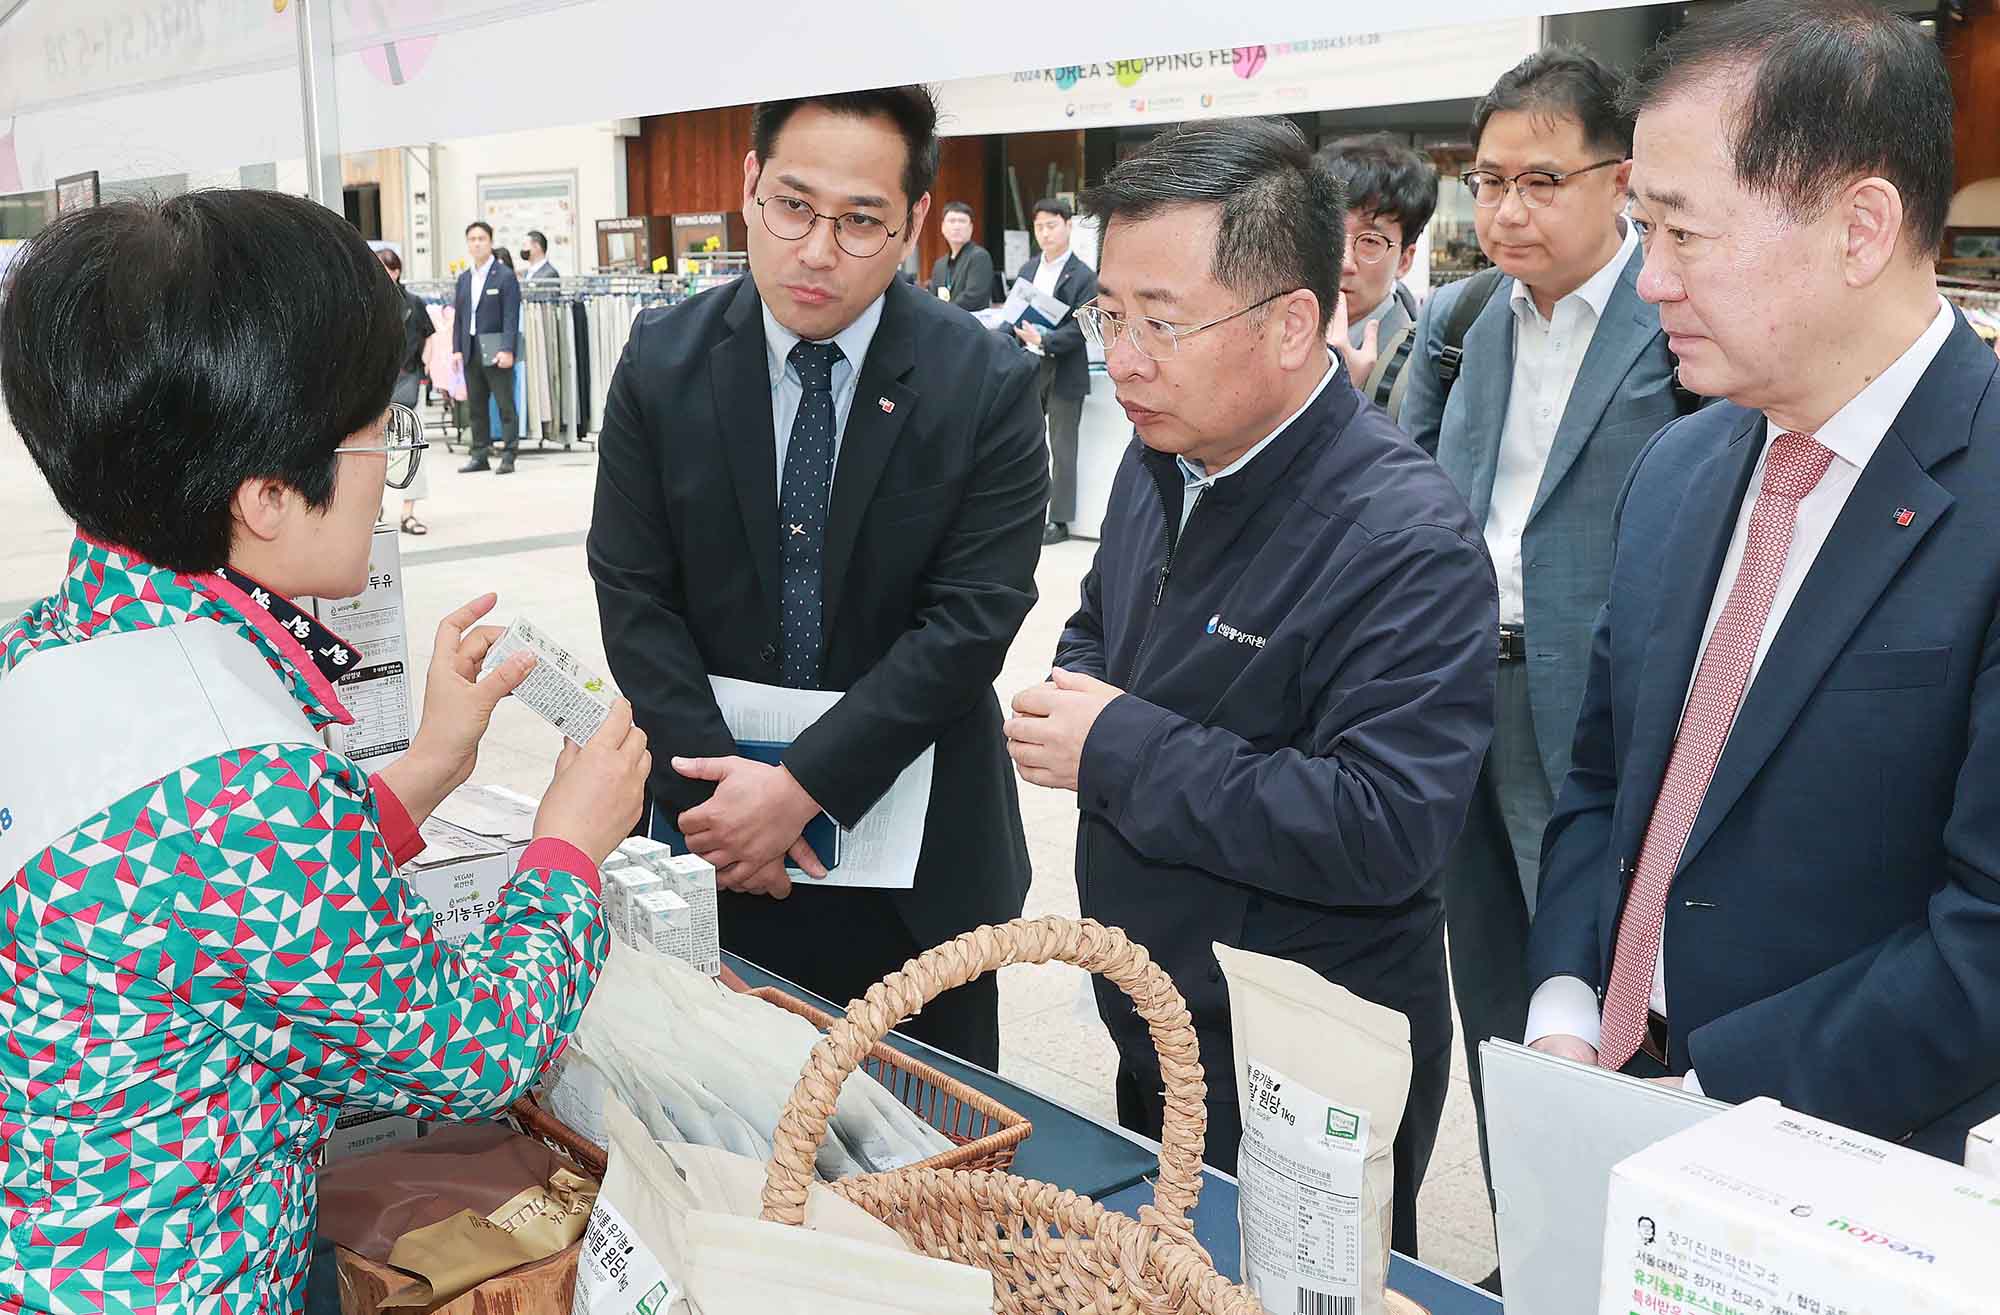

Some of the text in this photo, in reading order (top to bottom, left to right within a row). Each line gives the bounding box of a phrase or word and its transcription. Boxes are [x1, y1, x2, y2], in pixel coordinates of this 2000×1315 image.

[1044, 63, 1101, 82] KOREA
[1106, 50, 1203, 77] SHOPPING
[1209, 45, 1267, 66] FESTA
[454, 872, 474, 882] VEGAN
[1252, 1068, 1274, 1090] 유기농
[1259, 1089, 1281, 1115] 원당
[1281, 1107, 1296, 1127] 1kg
[606, 1223, 629, 1250] 유기농
[600, 1246, 628, 1278] 원당
[1634, 1249, 1689, 1281] 서울대학교
[1693, 1273, 1727, 1297] 정가진
